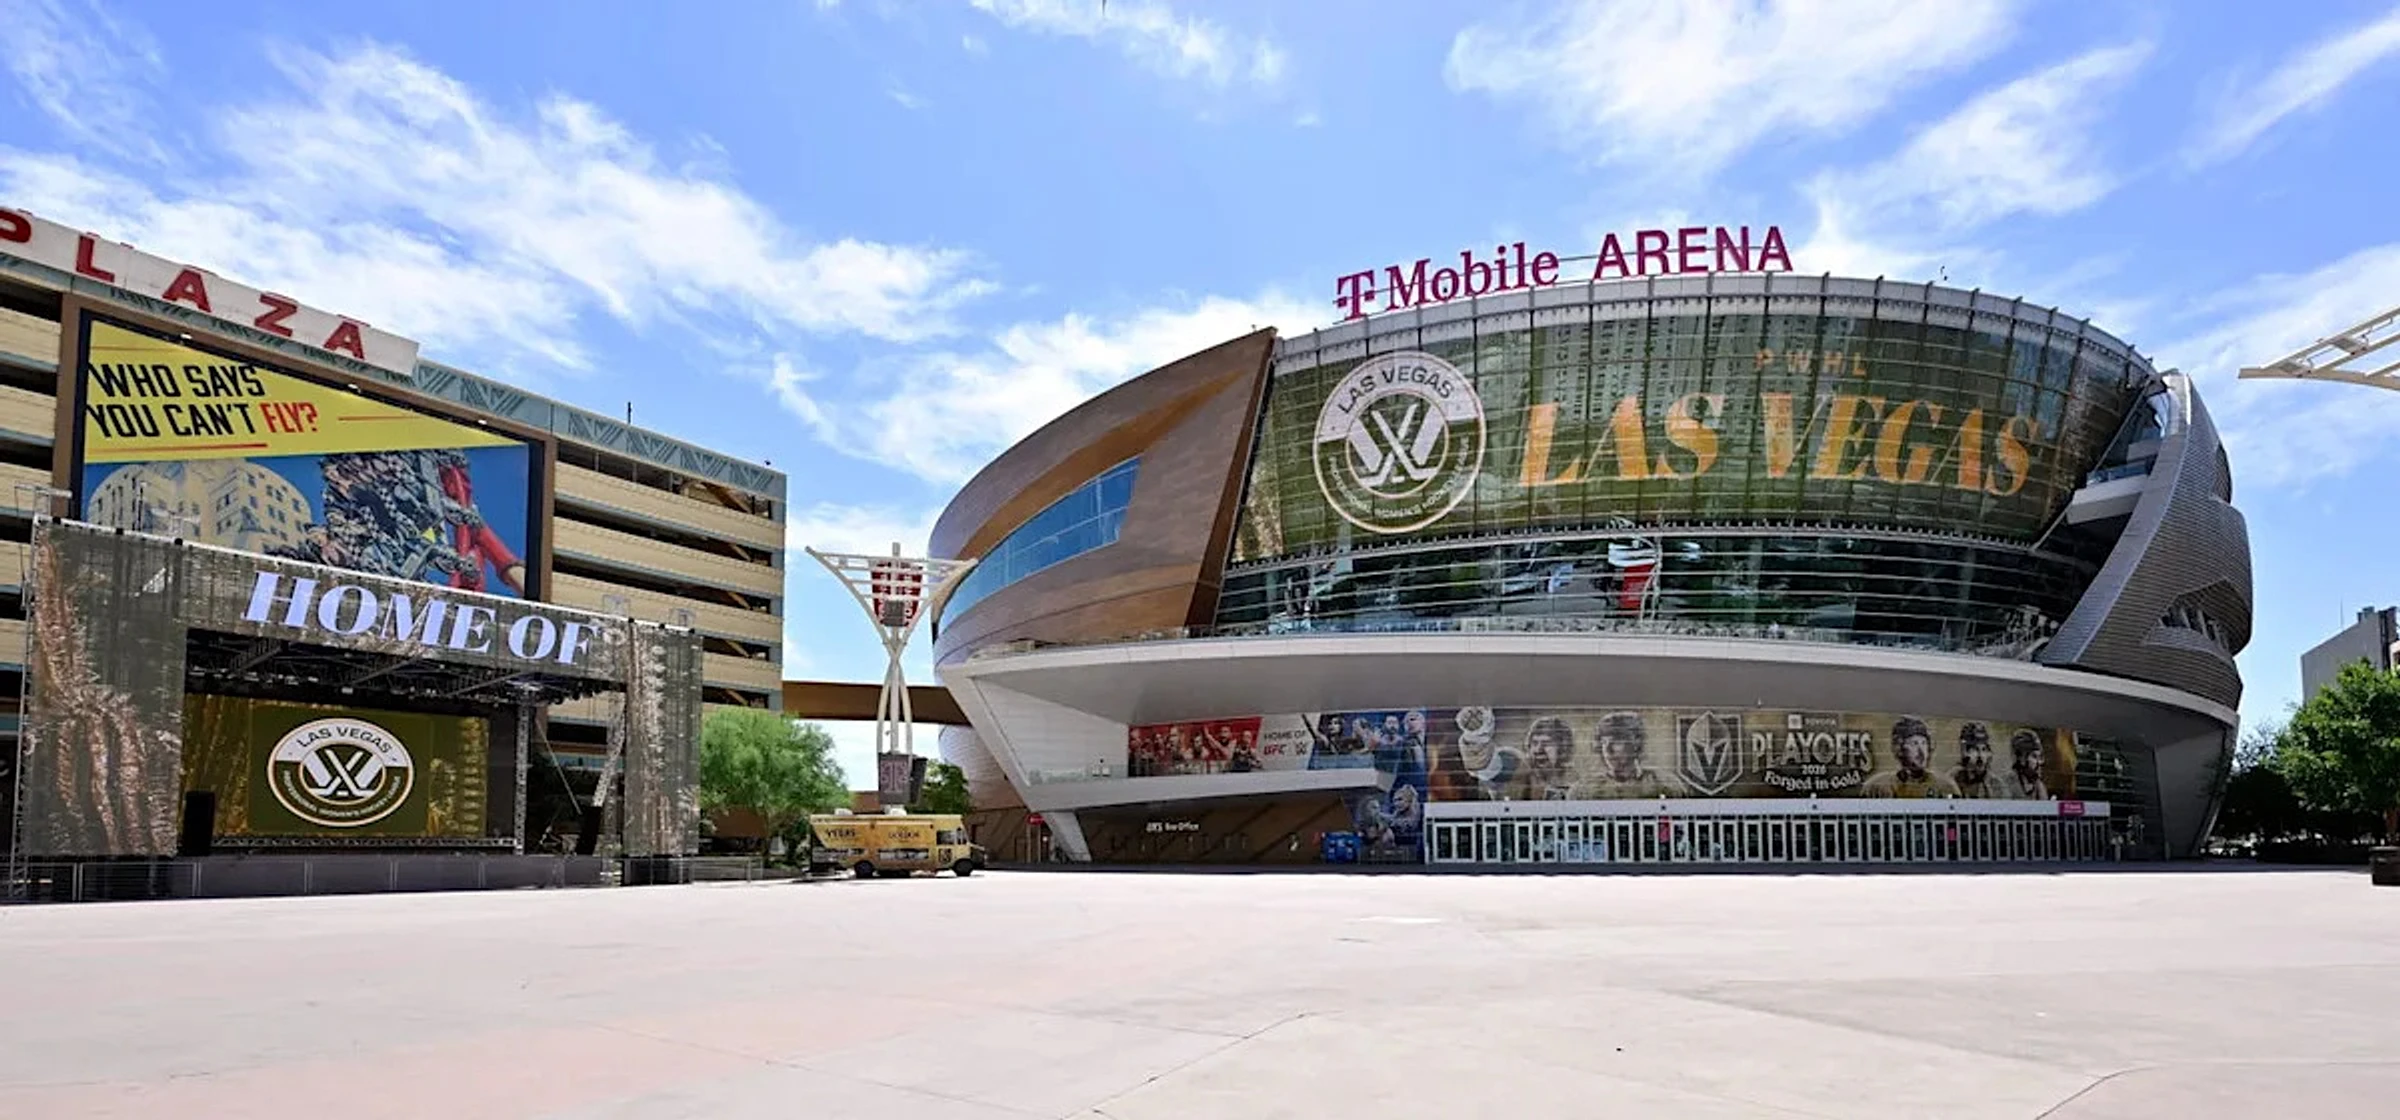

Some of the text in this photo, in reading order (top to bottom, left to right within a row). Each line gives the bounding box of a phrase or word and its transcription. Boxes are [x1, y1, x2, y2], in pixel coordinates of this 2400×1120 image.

[1594, 226, 1793, 280] ARENA
[0, 208, 365, 360] PLAZA
[88, 362, 266, 397] WHO SAYS
[1756, 349, 1867, 376] PWHL
[1338, 366, 1454, 414] LAS VEGAS
[86, 402, 318, 438] YOU CAN'T FLY?
[1520, 390, 2040, 496] LAS VEGAS
[241, 570, 600, 665] HOME OF
[296, 726, 392, 753] LAS VEGAS
[1752, 732, 1873, 773] PLAYOFFS
[1765, 770, 1861, 791] Forged in Gold
